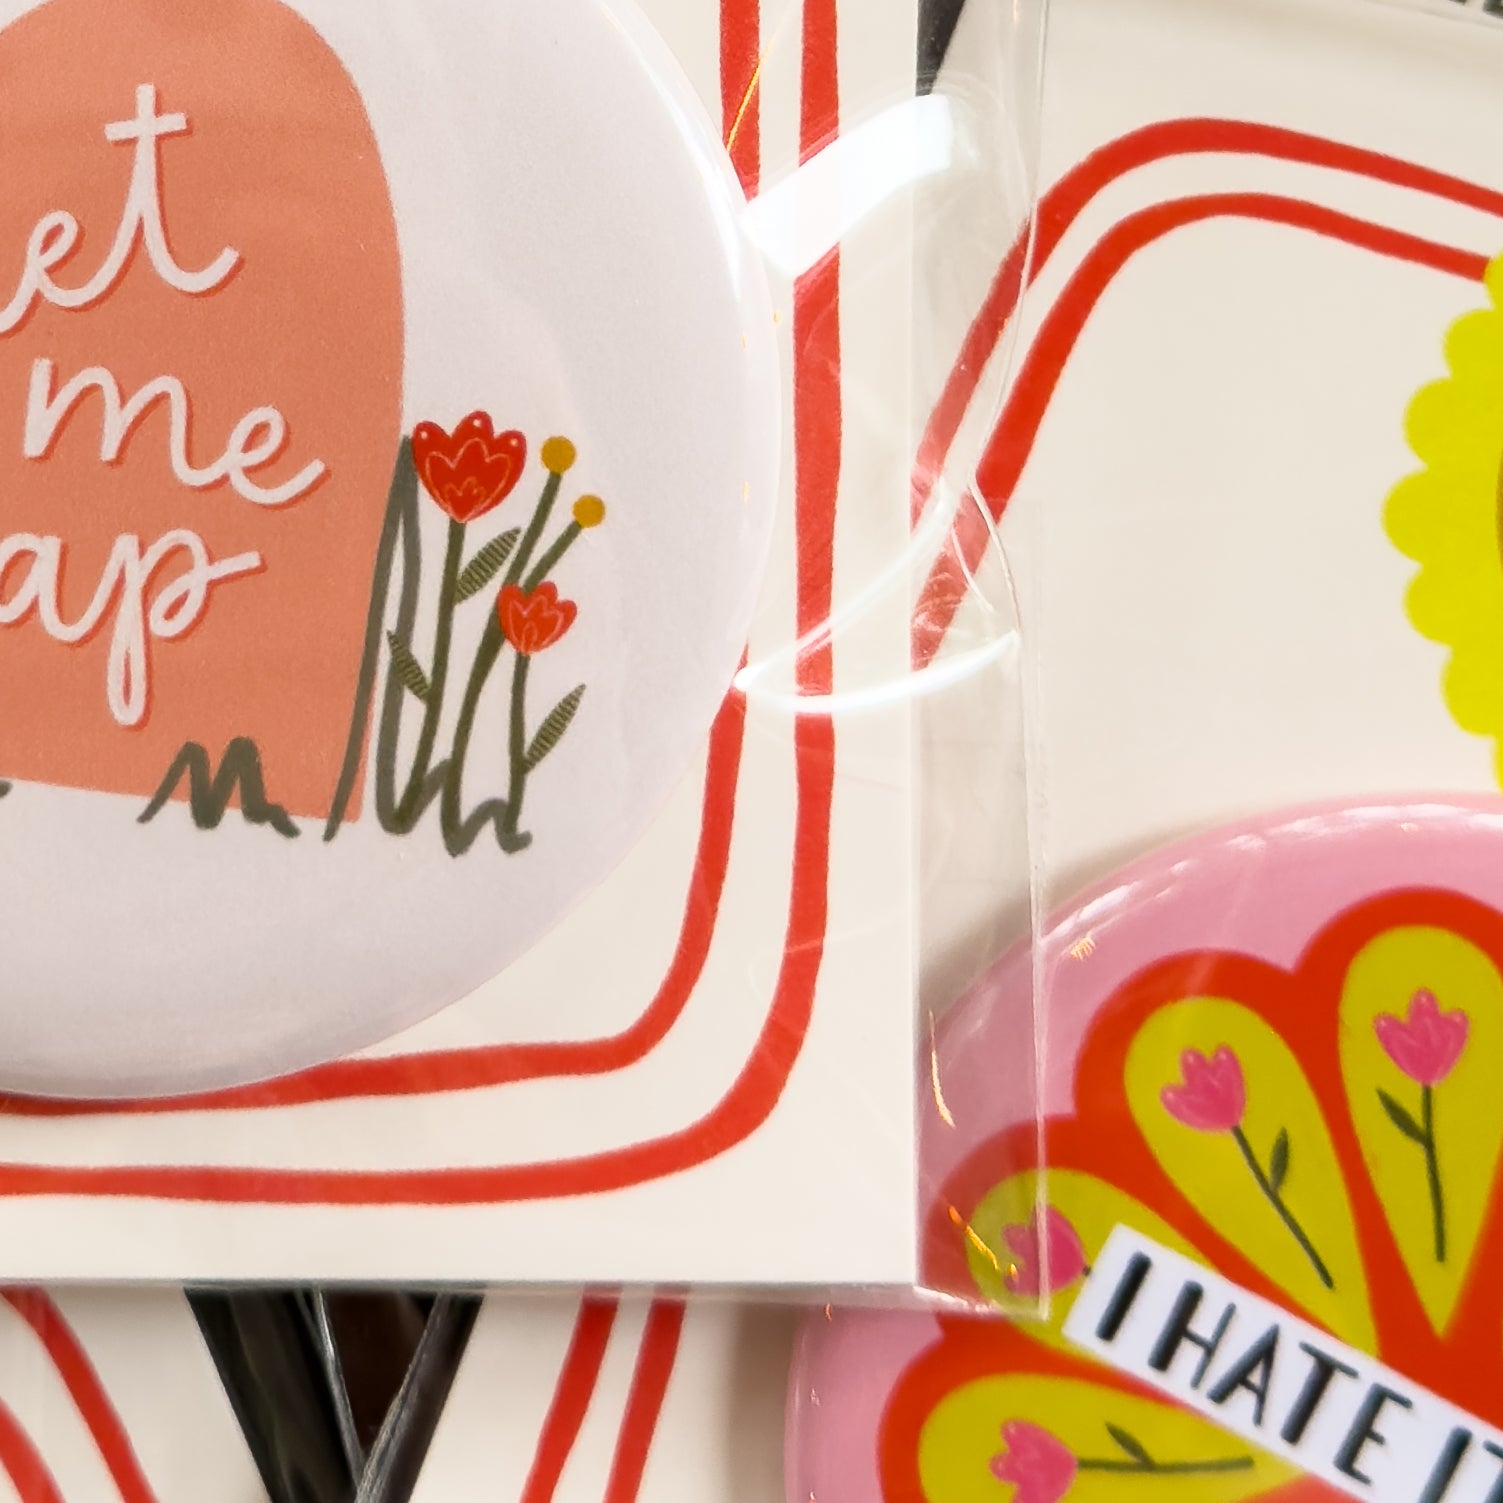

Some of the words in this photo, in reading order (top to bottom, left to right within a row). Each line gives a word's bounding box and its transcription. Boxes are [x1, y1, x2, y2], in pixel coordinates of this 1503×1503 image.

[22, 357, 330, 508] me
[1096, 1249, 1153, 1343] I
[1147, 1279, 1414, 1488] HATE
